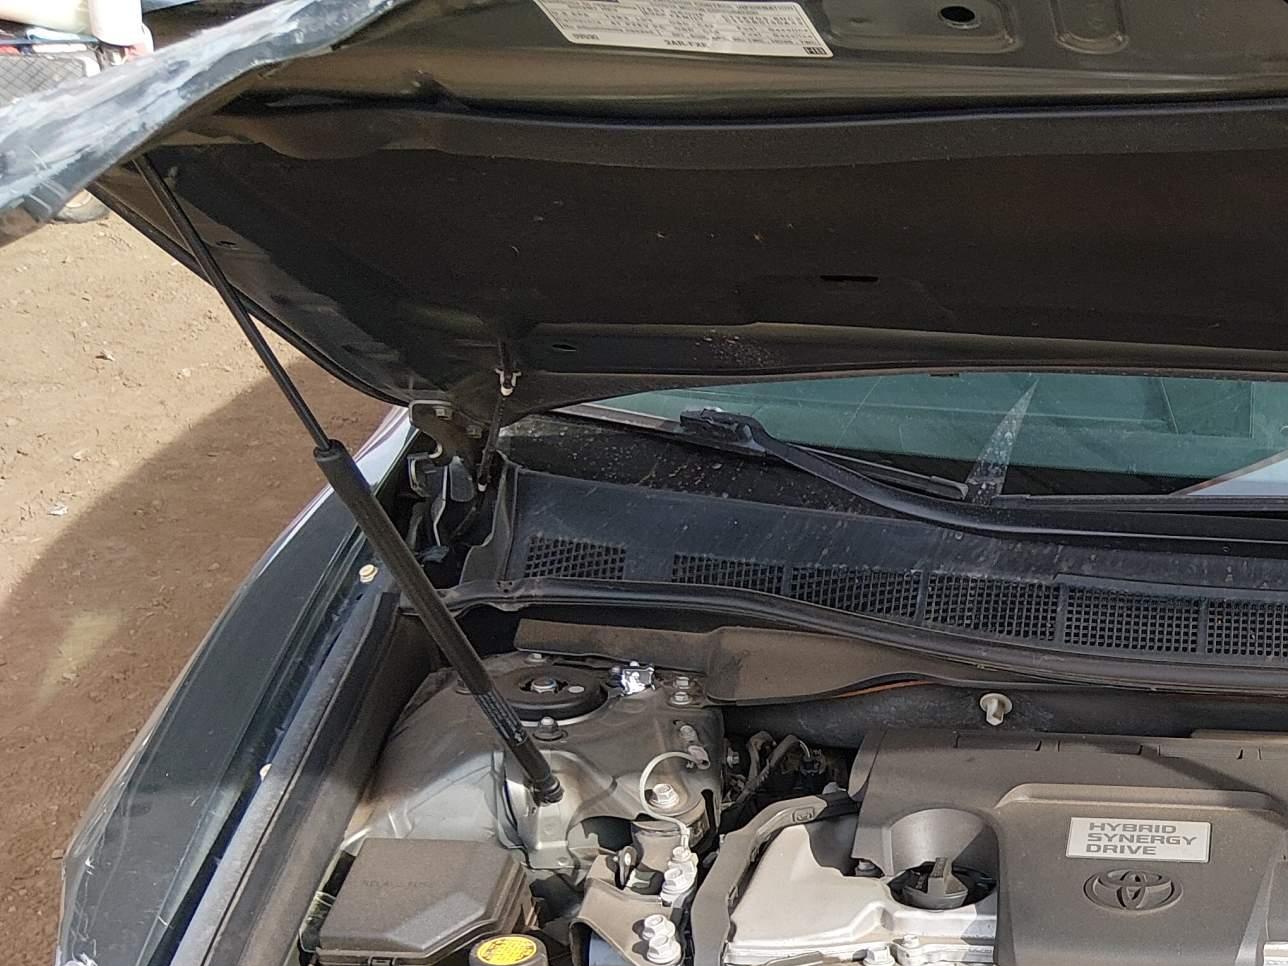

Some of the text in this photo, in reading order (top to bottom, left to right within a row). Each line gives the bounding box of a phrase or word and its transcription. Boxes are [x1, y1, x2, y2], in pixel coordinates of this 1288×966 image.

[1089, 822, 1177, 834] HYBRID
[1087, 832, 1197, 846] SYNERGY
[1086, 843, 1157, 856] DRIVE
